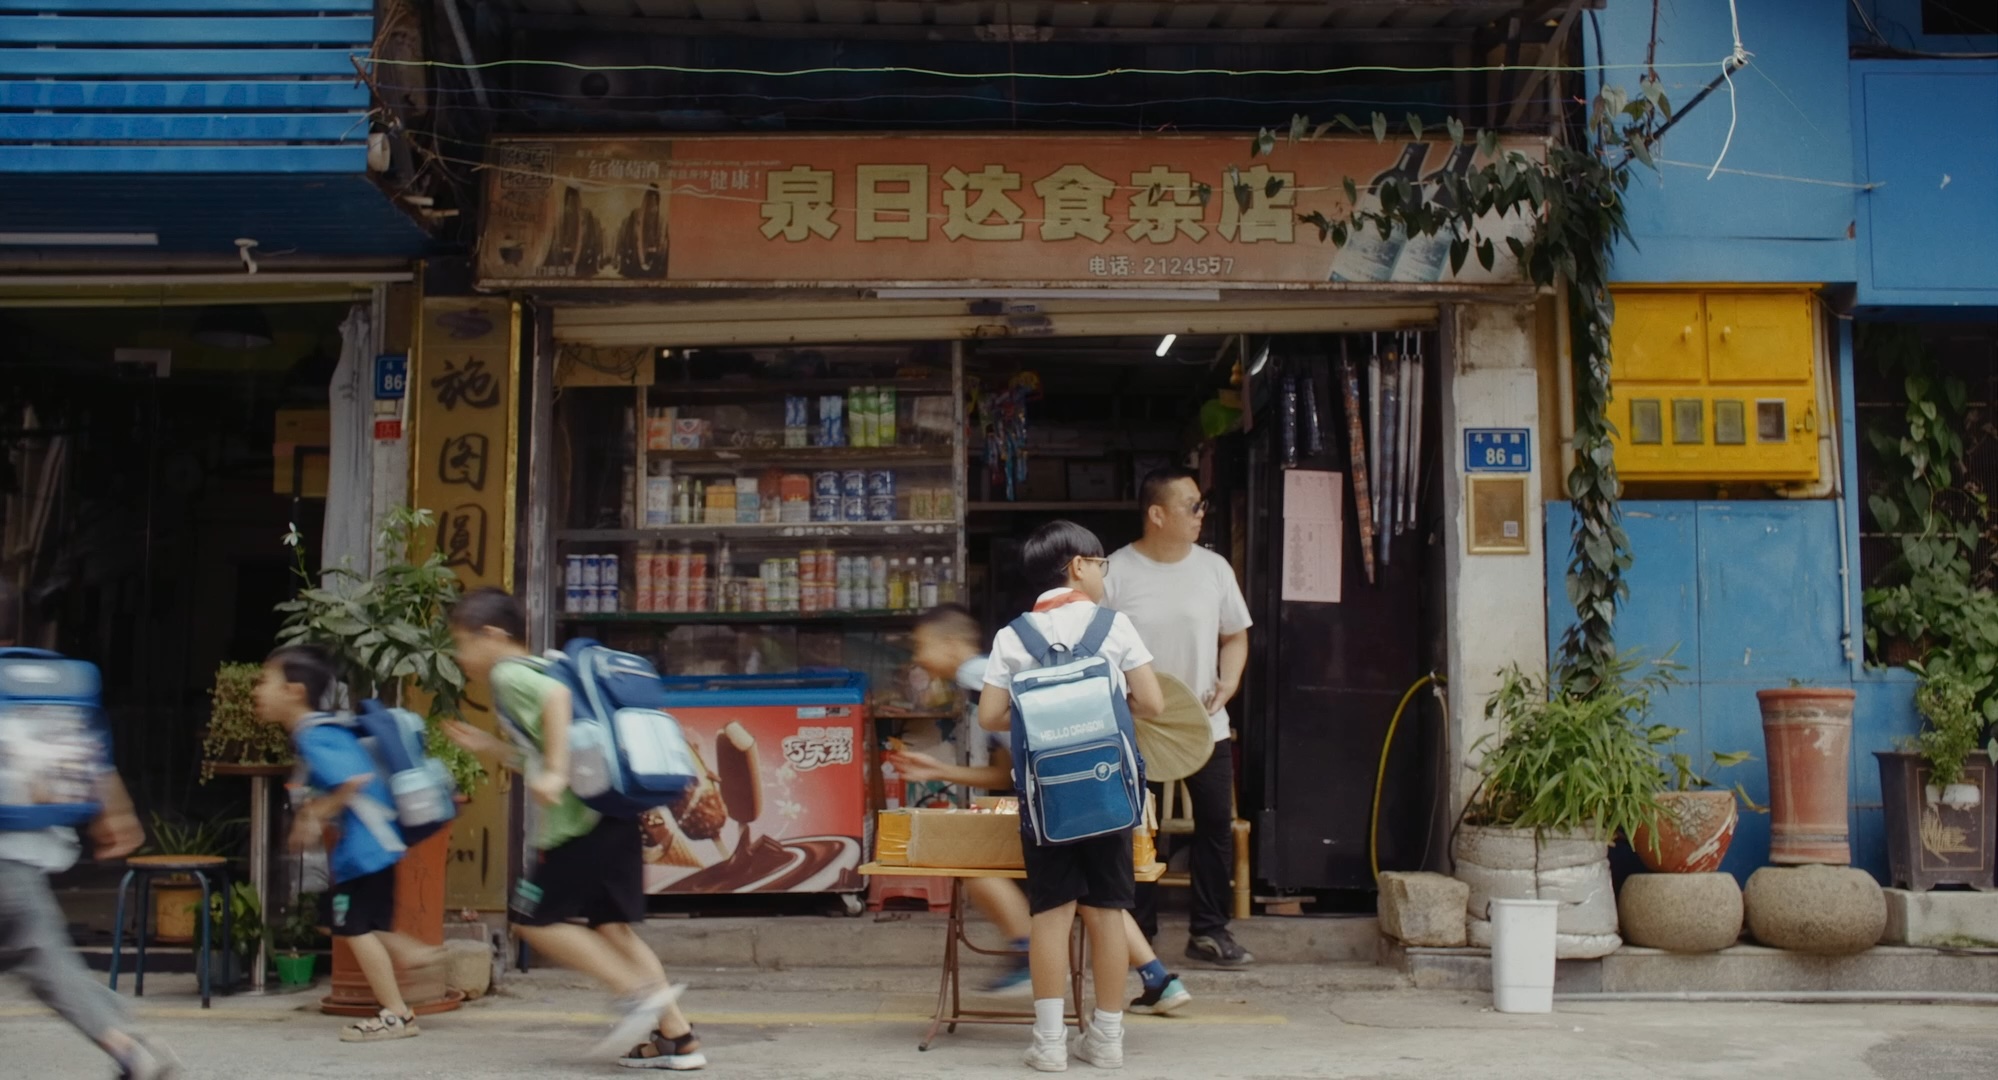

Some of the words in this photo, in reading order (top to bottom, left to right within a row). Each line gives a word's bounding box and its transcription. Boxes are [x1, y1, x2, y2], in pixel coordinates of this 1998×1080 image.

[759, 163, 1297, 244] 泉日达食杂店
[1088, 255, 1136, 276] 电话:
[1143, 255, 1235, 275] 2124557
[1485, 447, 1507, 465] 86
[1040, 726, 1070, 742] HELLO
[1069, 719, 1105, 737] DRAGON
